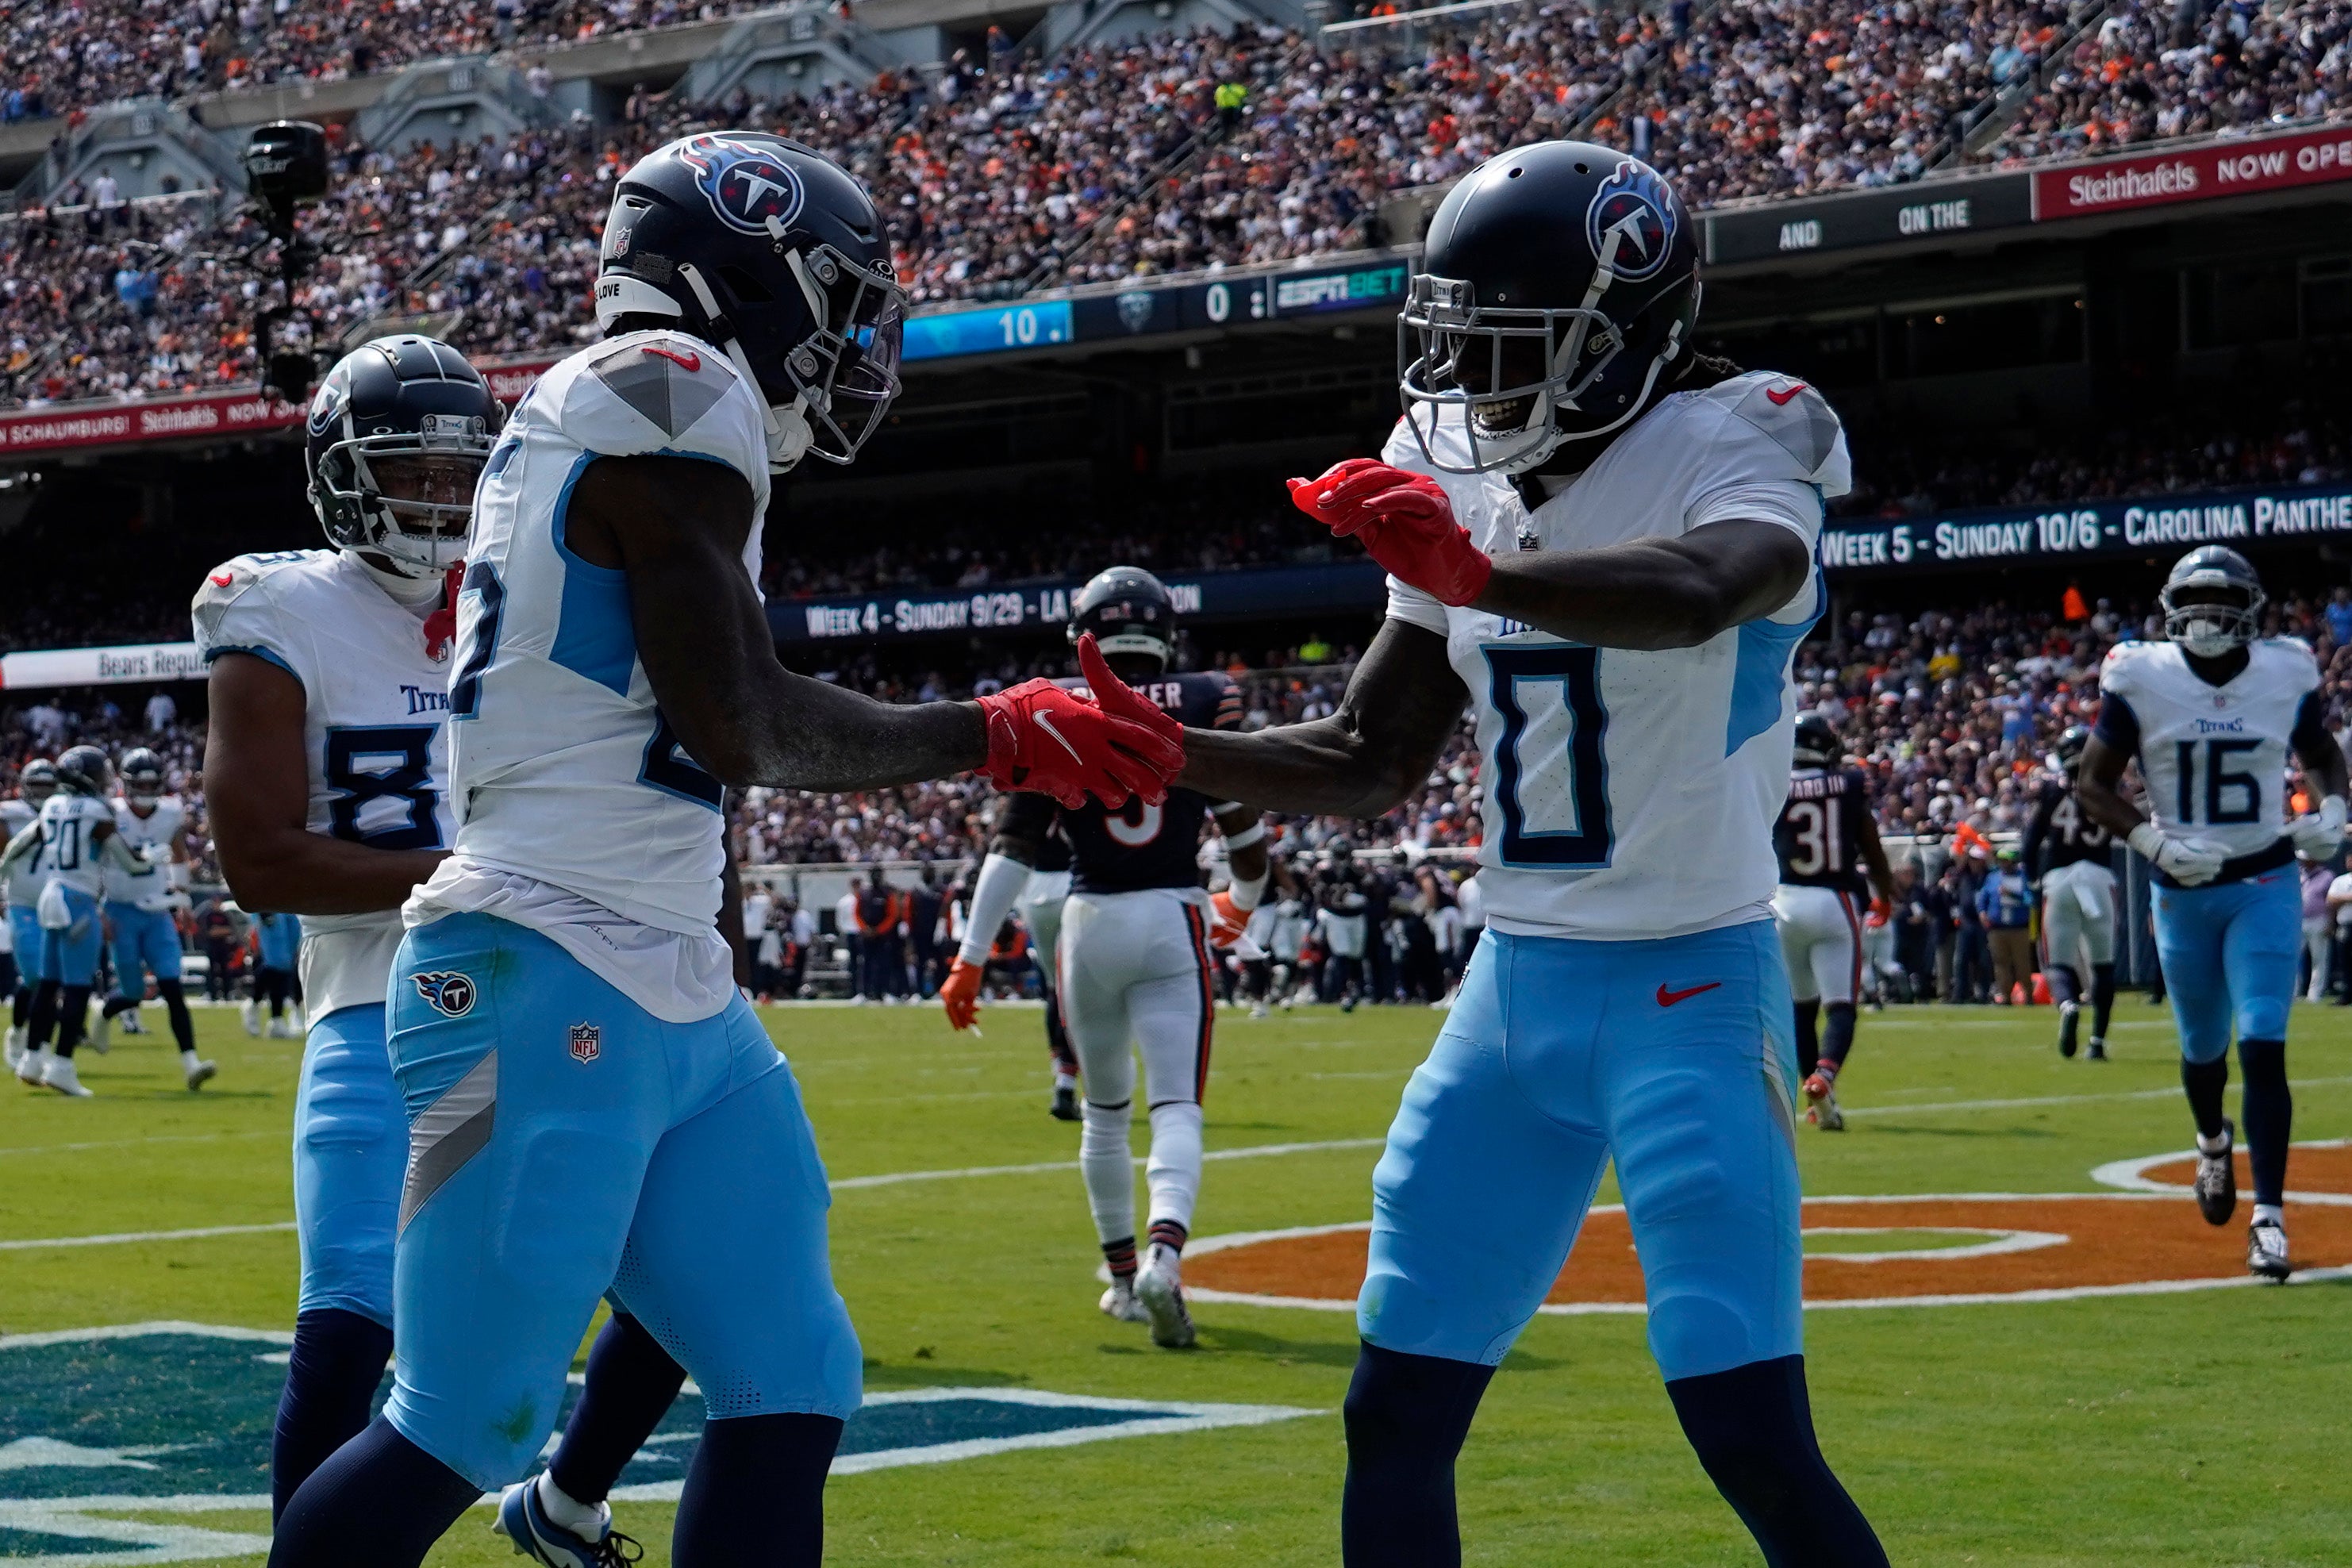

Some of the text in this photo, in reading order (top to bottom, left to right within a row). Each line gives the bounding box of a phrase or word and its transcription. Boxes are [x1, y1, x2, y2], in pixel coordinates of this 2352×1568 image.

[2069, 161, 2199, 206] Steinhafels
[2218, 150, 2288, 183] NOW
[1779, 199, 1970, 251] AND ON THE
[598, 283, 620, 300] LOVE
[1206, 283, 1229, 322] 0
[1277, 267, 1405, 308] ESPN BET
[999, 309, 1036, 346] 10
[1821, 531, 1889, 568] WEEK
[1893, 525, 1913, 563] 5
[1935, 521, 2033, 560] SUNDAY
[2036, 510, 2100, 551] 10/6
[2124, 506, 2250, 546] CAROLINA
[805, 606, 861, 638] WEEK
[862, 602, 879, 634] 4
[894, 600, 970, 632] SUNDAY
[970, 593, 1024, 627] 9/29
[1040, 590, 1069, 623] LA
[99, 653, 148, 677] Bears
[2196, 717, 2243, 733] TITANS
[1479, 642, 1615, 868] 0
[2176, 738, 2265, 825] 16
[1786, 797, 1841, 876] 31
[575, 1040, 596, 1056] NFL
